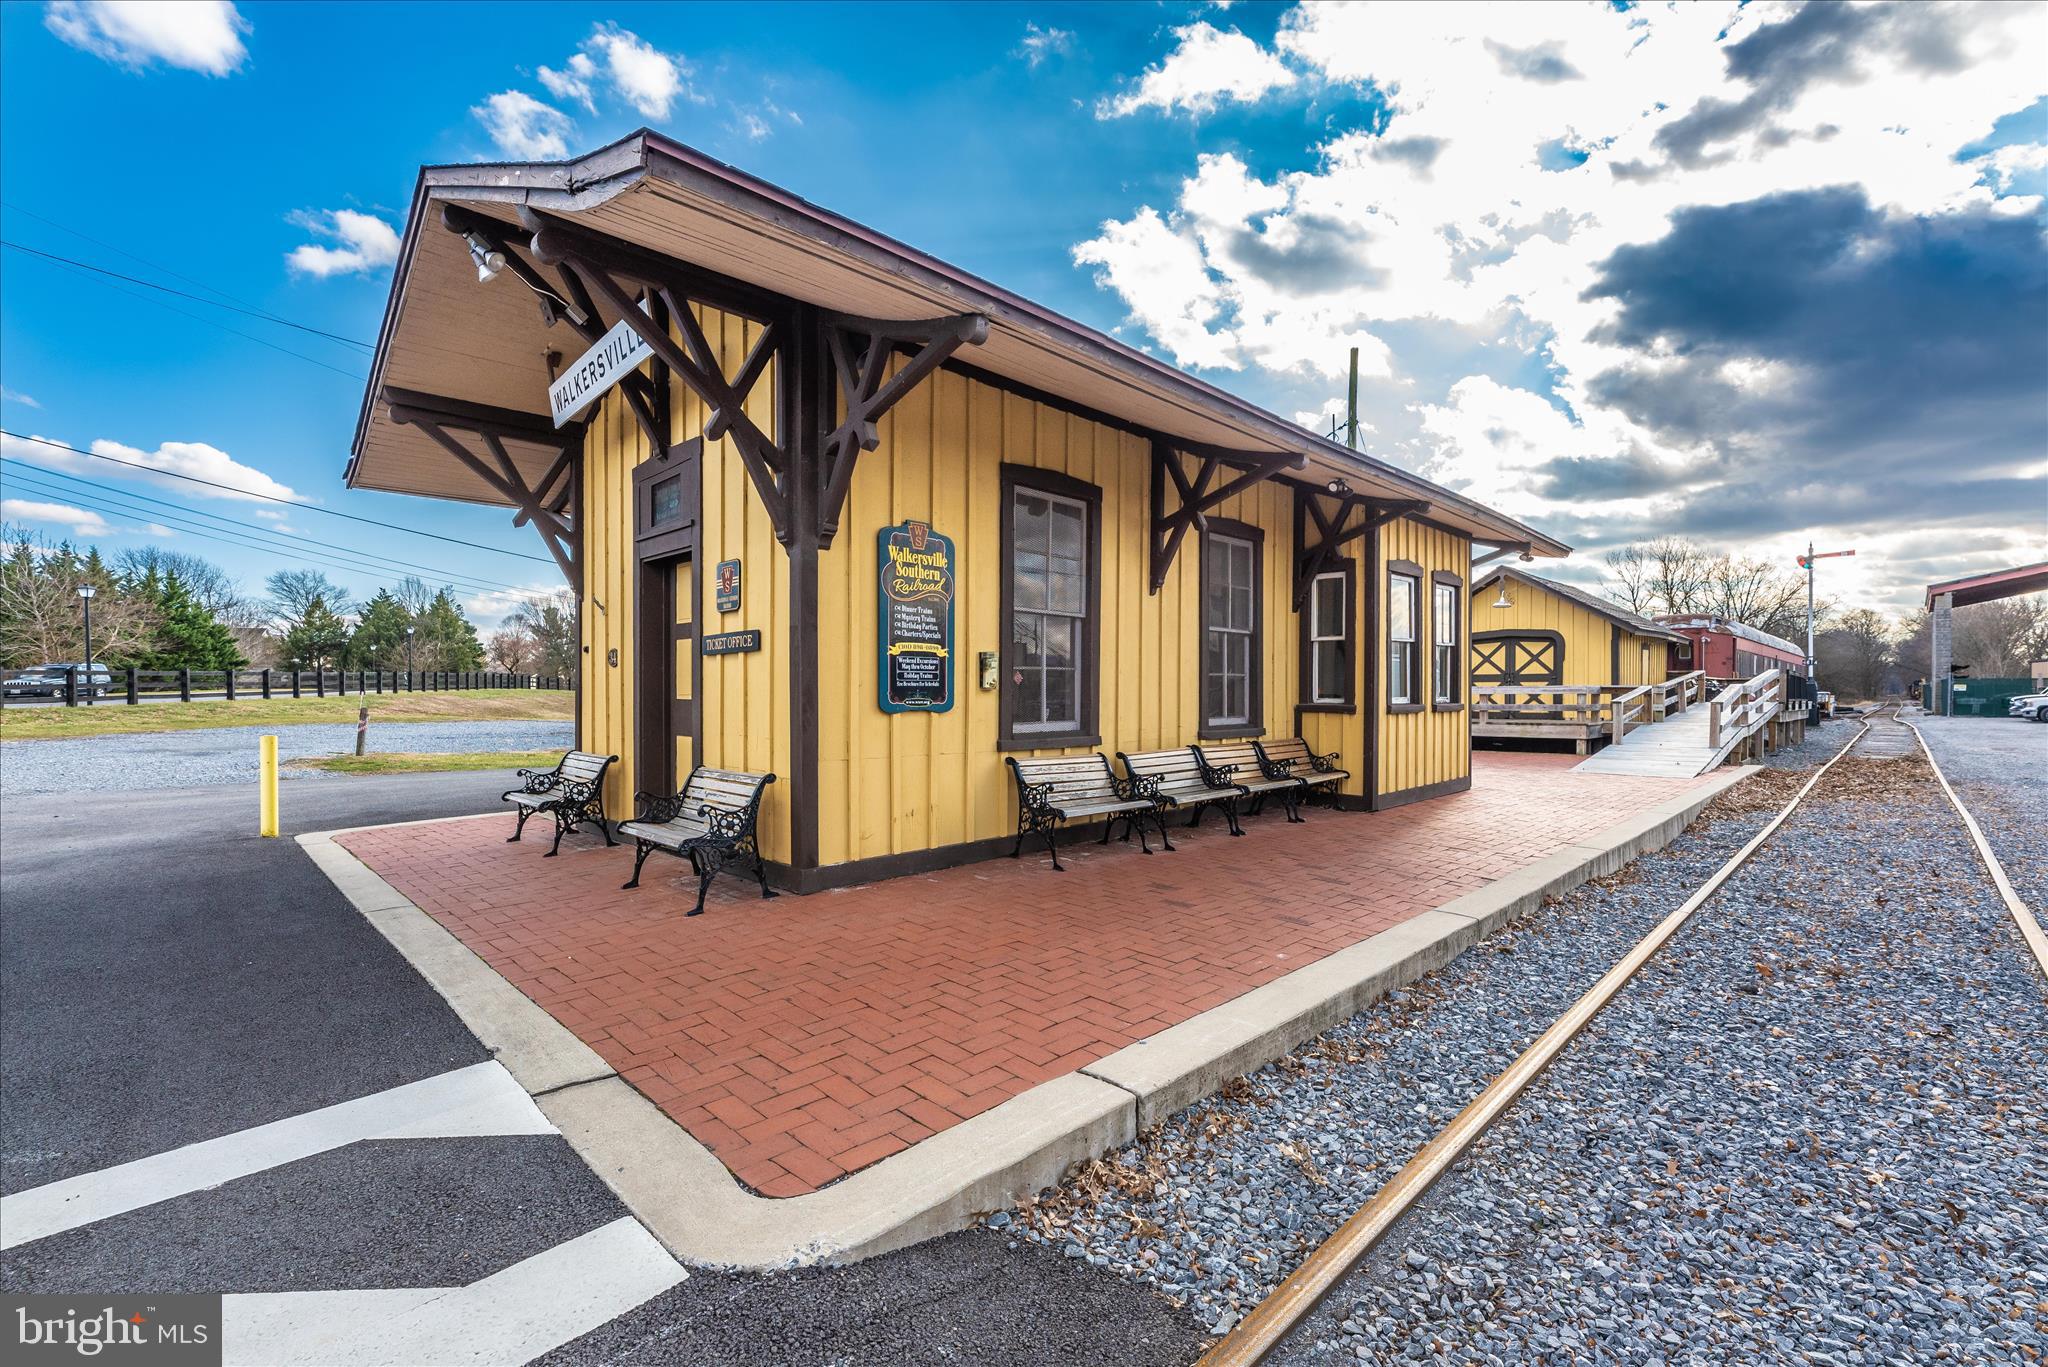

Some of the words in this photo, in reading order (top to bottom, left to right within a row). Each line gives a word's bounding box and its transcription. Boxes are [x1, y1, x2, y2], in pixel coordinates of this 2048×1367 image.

[914, 525, 923, 536] W
[915, 536, 922, 546] S
[888, 545, 947, 568] Walkersville
[723, 568, 731, 578] W
[896, 562, 940, 581] Southern
[725, 581, 730, 592] S
[893, 578, 945, 594] Railroad
[706, 637, 727, 651] TICKET
[728, 634, 753, 649] OFFICE
